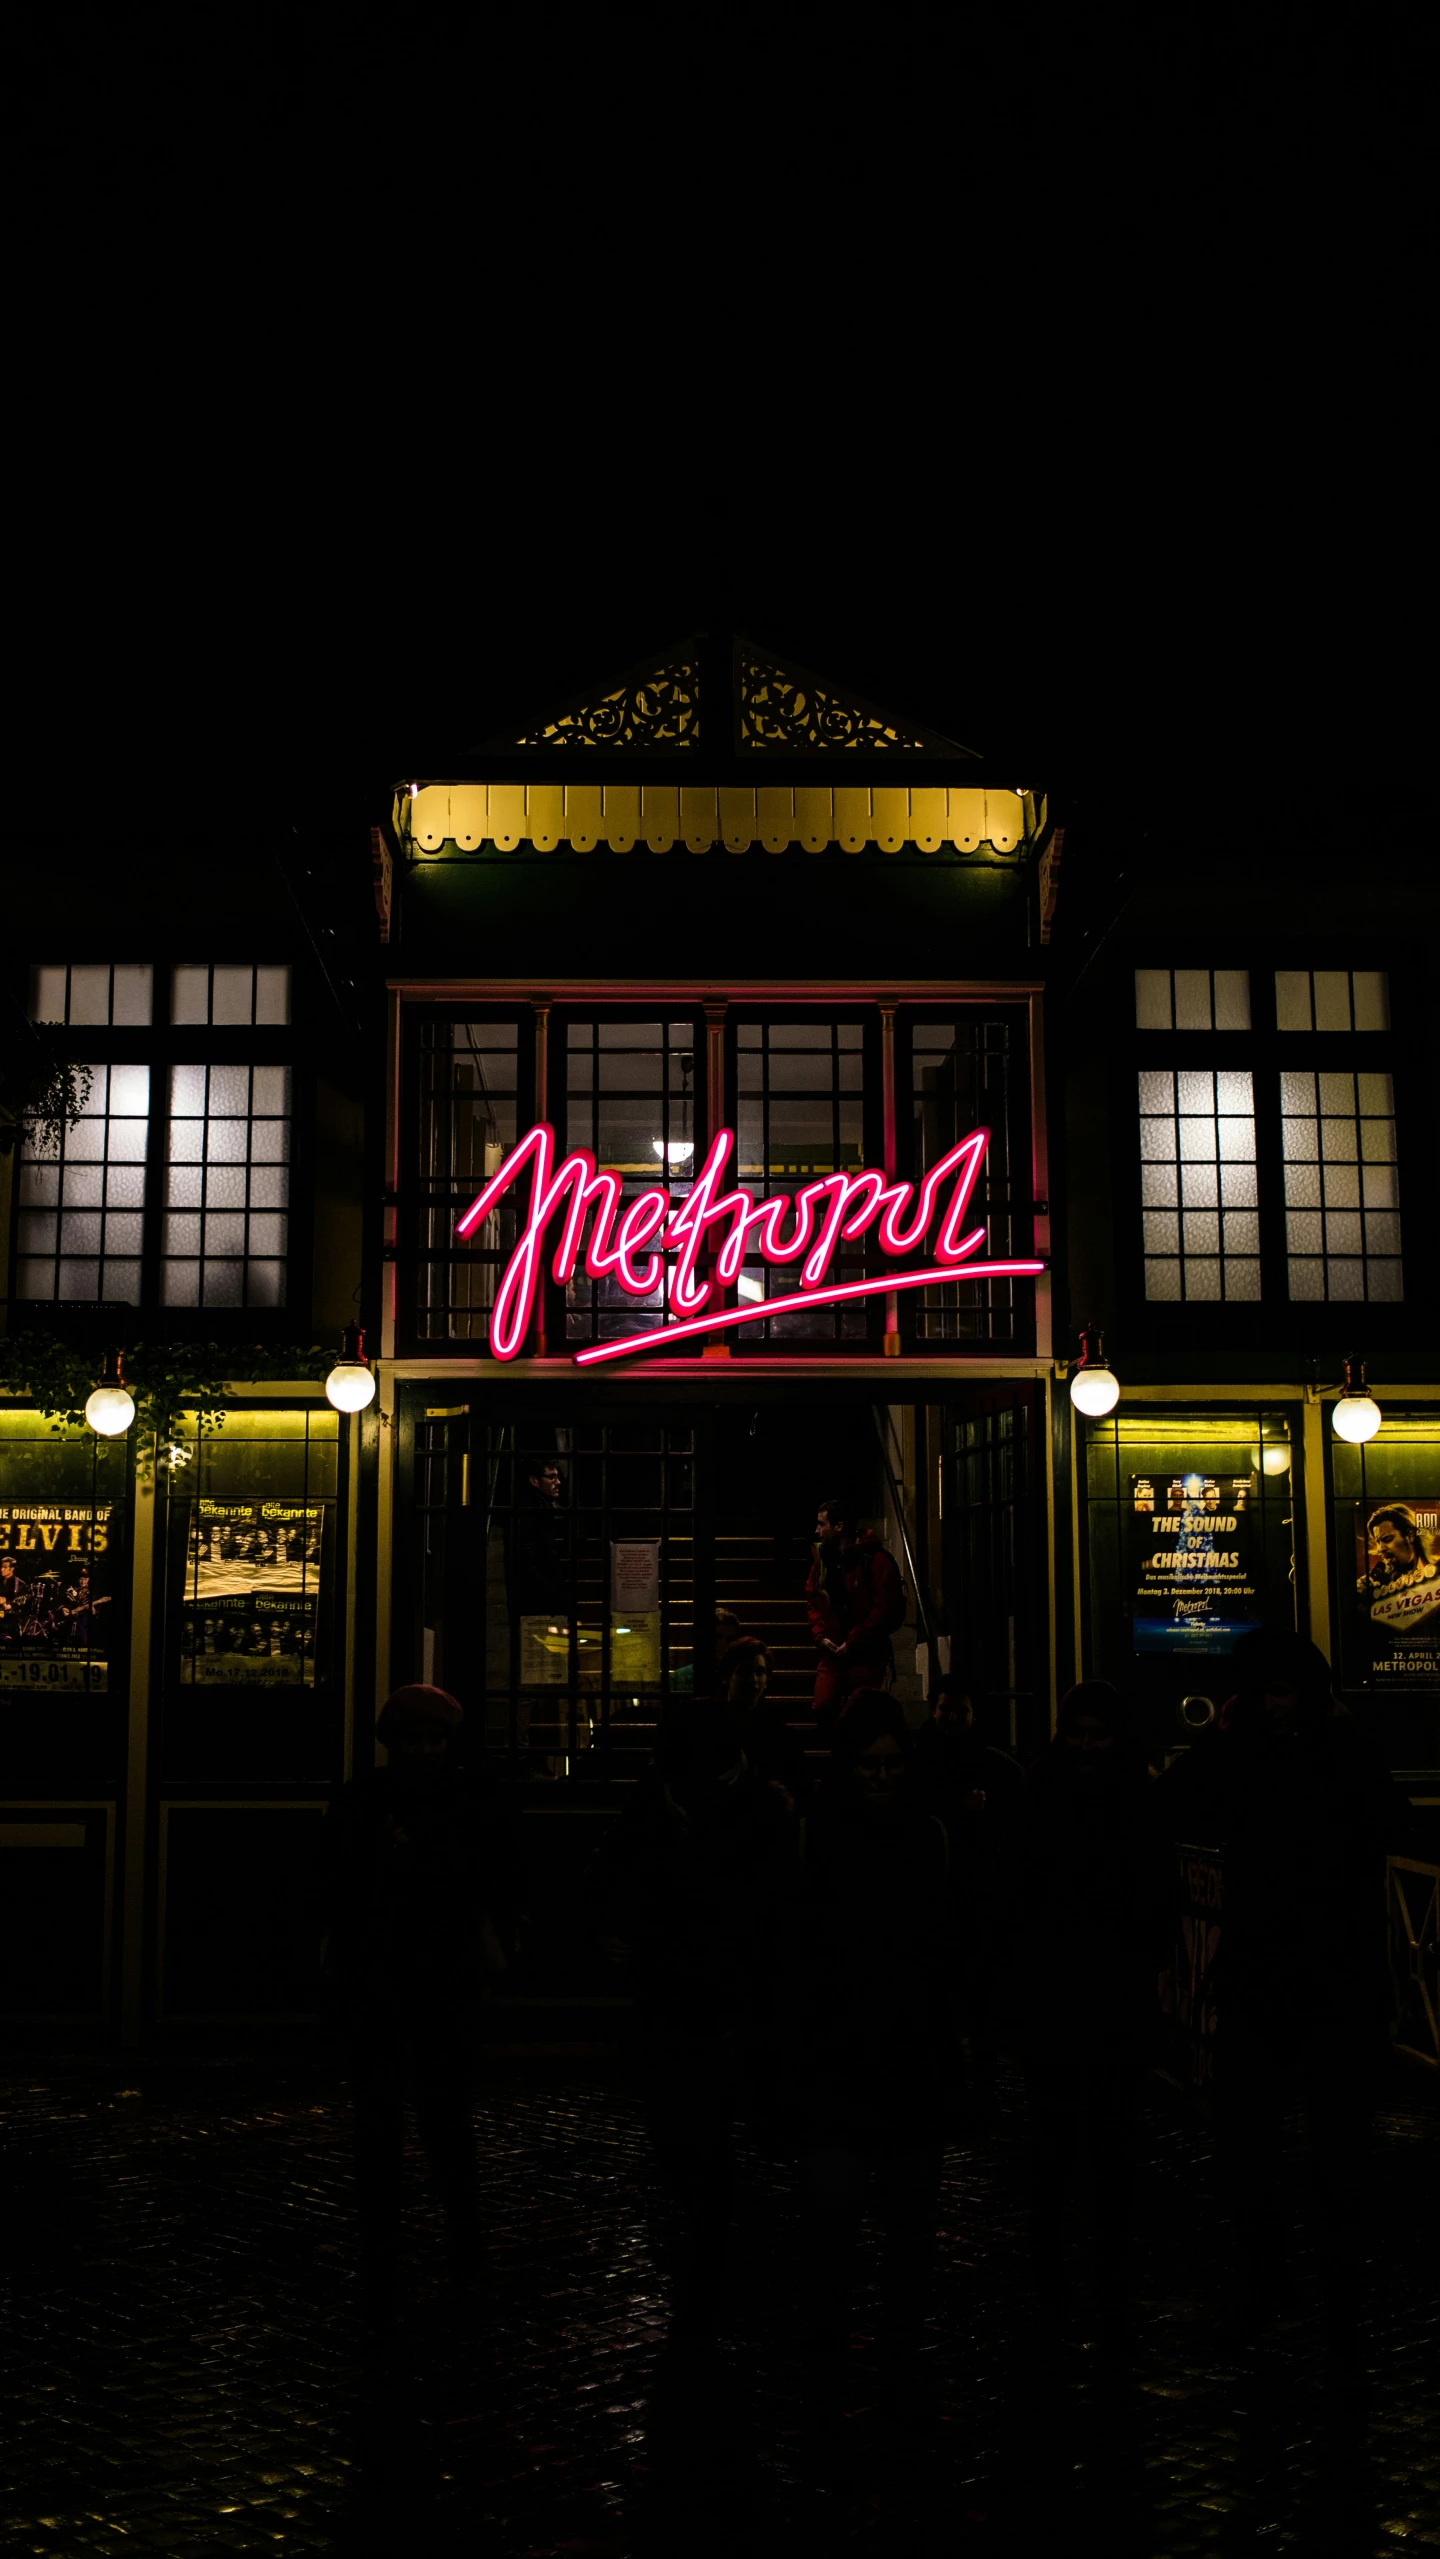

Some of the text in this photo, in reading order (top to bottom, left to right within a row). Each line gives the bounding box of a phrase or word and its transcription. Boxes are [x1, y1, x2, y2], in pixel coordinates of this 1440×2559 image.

[456, 1121, 992, 1362] Metropol
[0, 1508, 110, 1521] E ORIGINAL BAND OF
[262, 1504, 318, 1518] bekannte
[1151, 1516, 1237, 1533] THE SOUND
[1186, 1536, 1203, 1549] OF
[1151, 1552, 1239, 1568] CHRISTMAS
[1136, 1588, 1162, 1597] Montag
[1171, 1587, 1203, 1595] Dezember
[1204, 1587, 1222, 1596] 2018,
[1243, 1587, 1255, 1595] Uhr
[1172, 1596, 1212, 1617] Metropol
[1373, 1603, 1392, 1616] LAS
[1402, 1607, 1424, 1617] SHOW
[1393, 1652, 1407, 1660] 12.
[1408, 1652, 1434, 1660] APRIL
[1372, 1661, 1438, 1671] METROPOL
